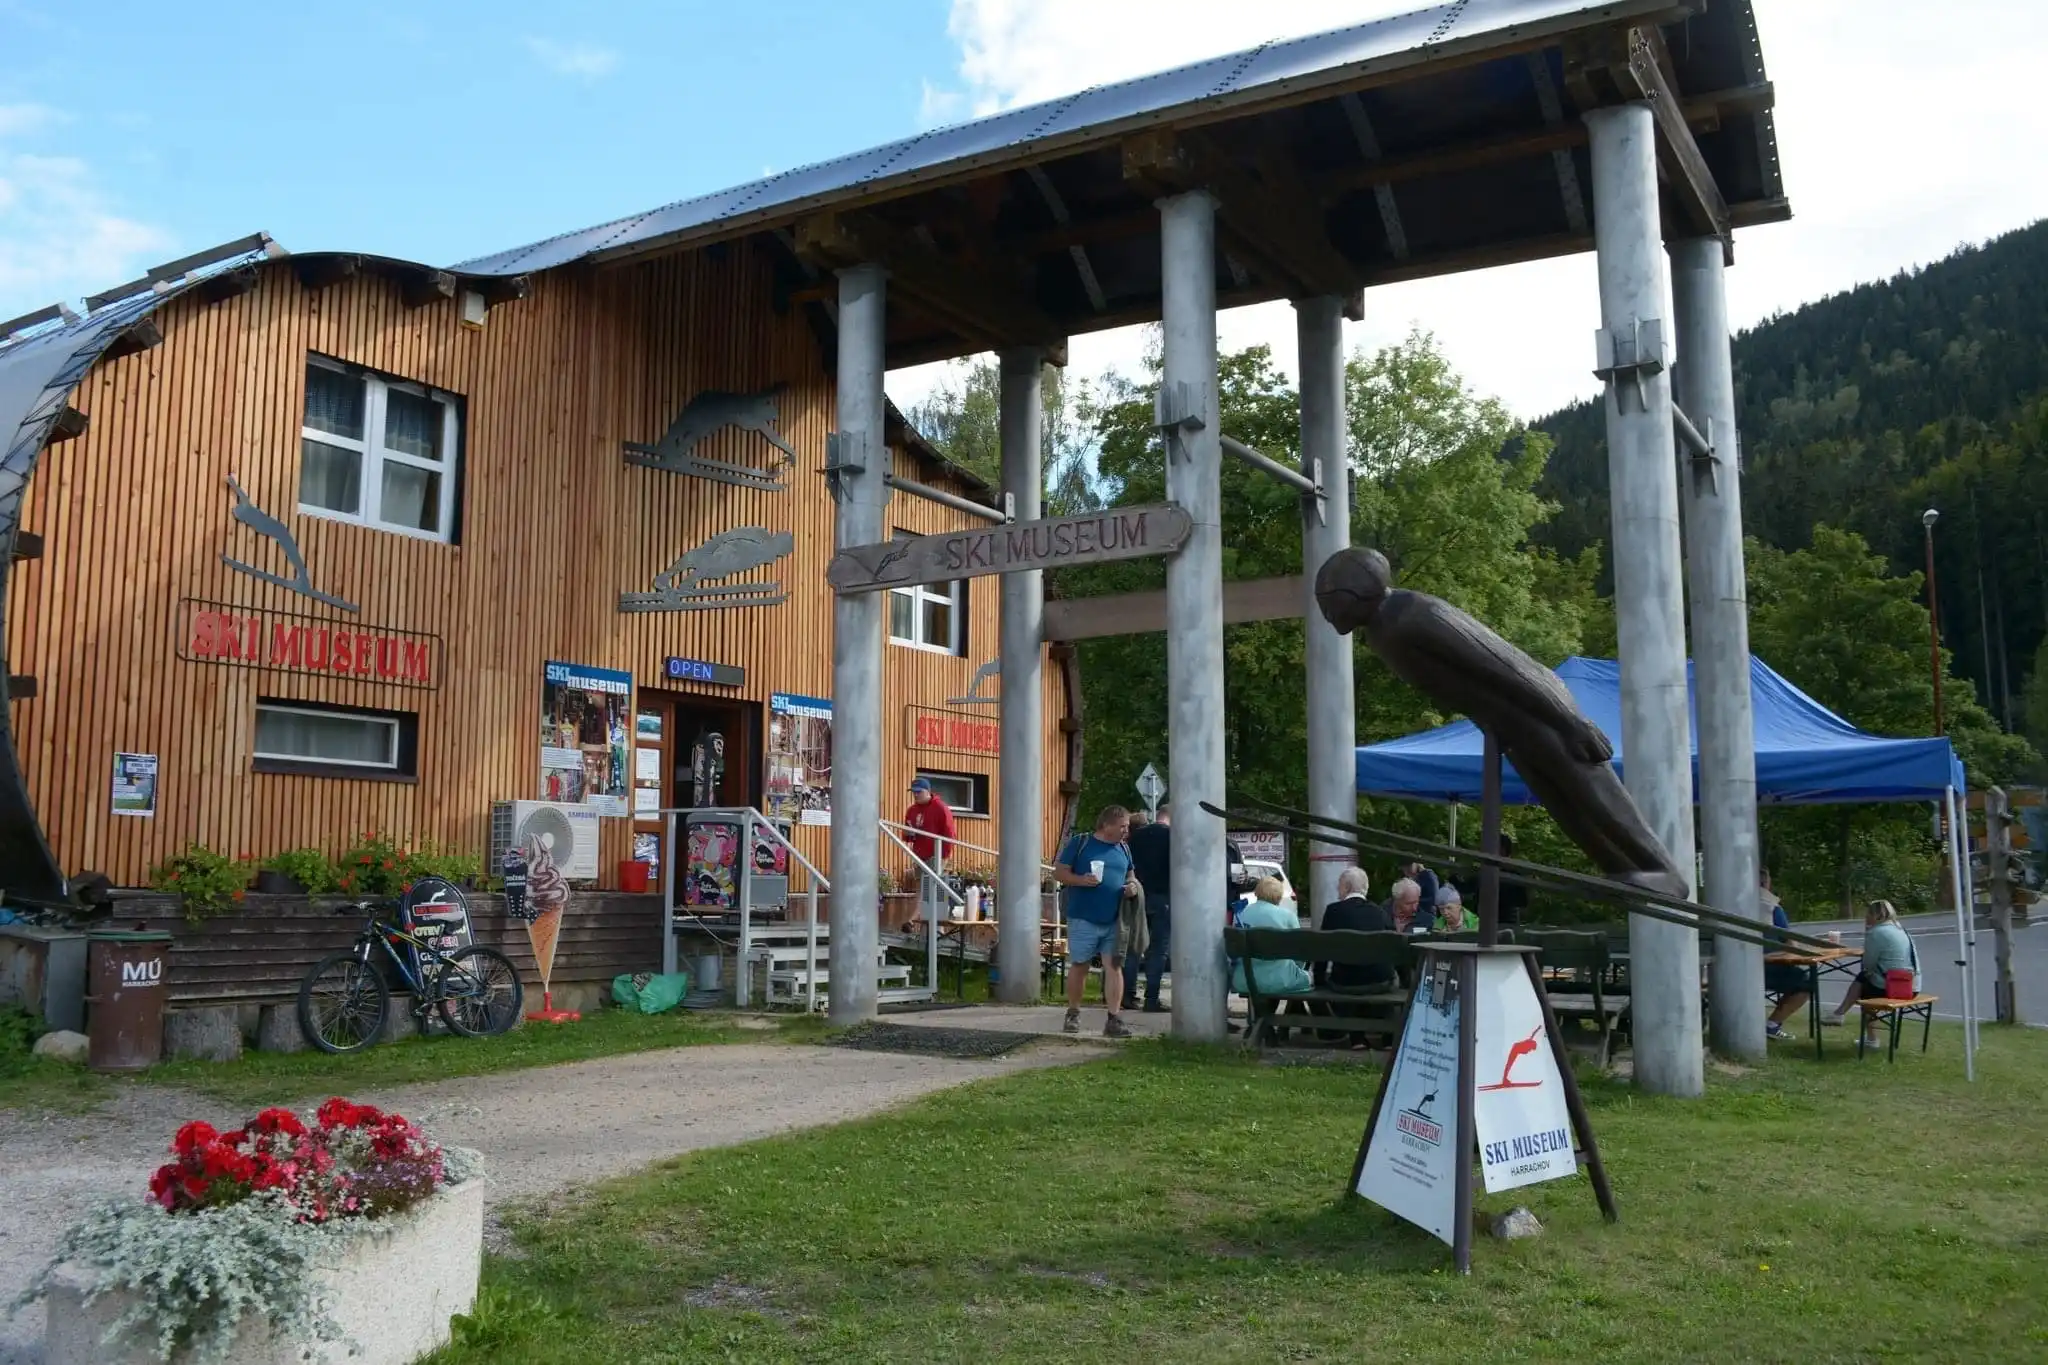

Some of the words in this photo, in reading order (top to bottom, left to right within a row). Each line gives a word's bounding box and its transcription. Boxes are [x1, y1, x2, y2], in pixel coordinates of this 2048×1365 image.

[946, 536, 993, 571] SKI
[1006, 513, 1148, 563] MUSEUM
[191, 611, 260, 661] SKI
[272, 623, 430, 682] MUSEUM
[546, 664, 570, 682] SKI
[670, 659, 712, 680] OPEN
[567, 675, 629, 695] museum
[771, 695, 789, 709] SKI
[917, 716, 945, 746] SKI
[1250, 833, 1275, 843] 007
[123, 957, 161, 980] MÚ
[1399, 1114, 1410, 1131] SKI
[1411, 1118, 1440, 1143] MUSEUM
[1485, 1140, 1509, 1166] SKI
[1512, 1128, 1569, 1160] MUSEUM
[1510, 1160, 1551, 1177] HARRACHOV
